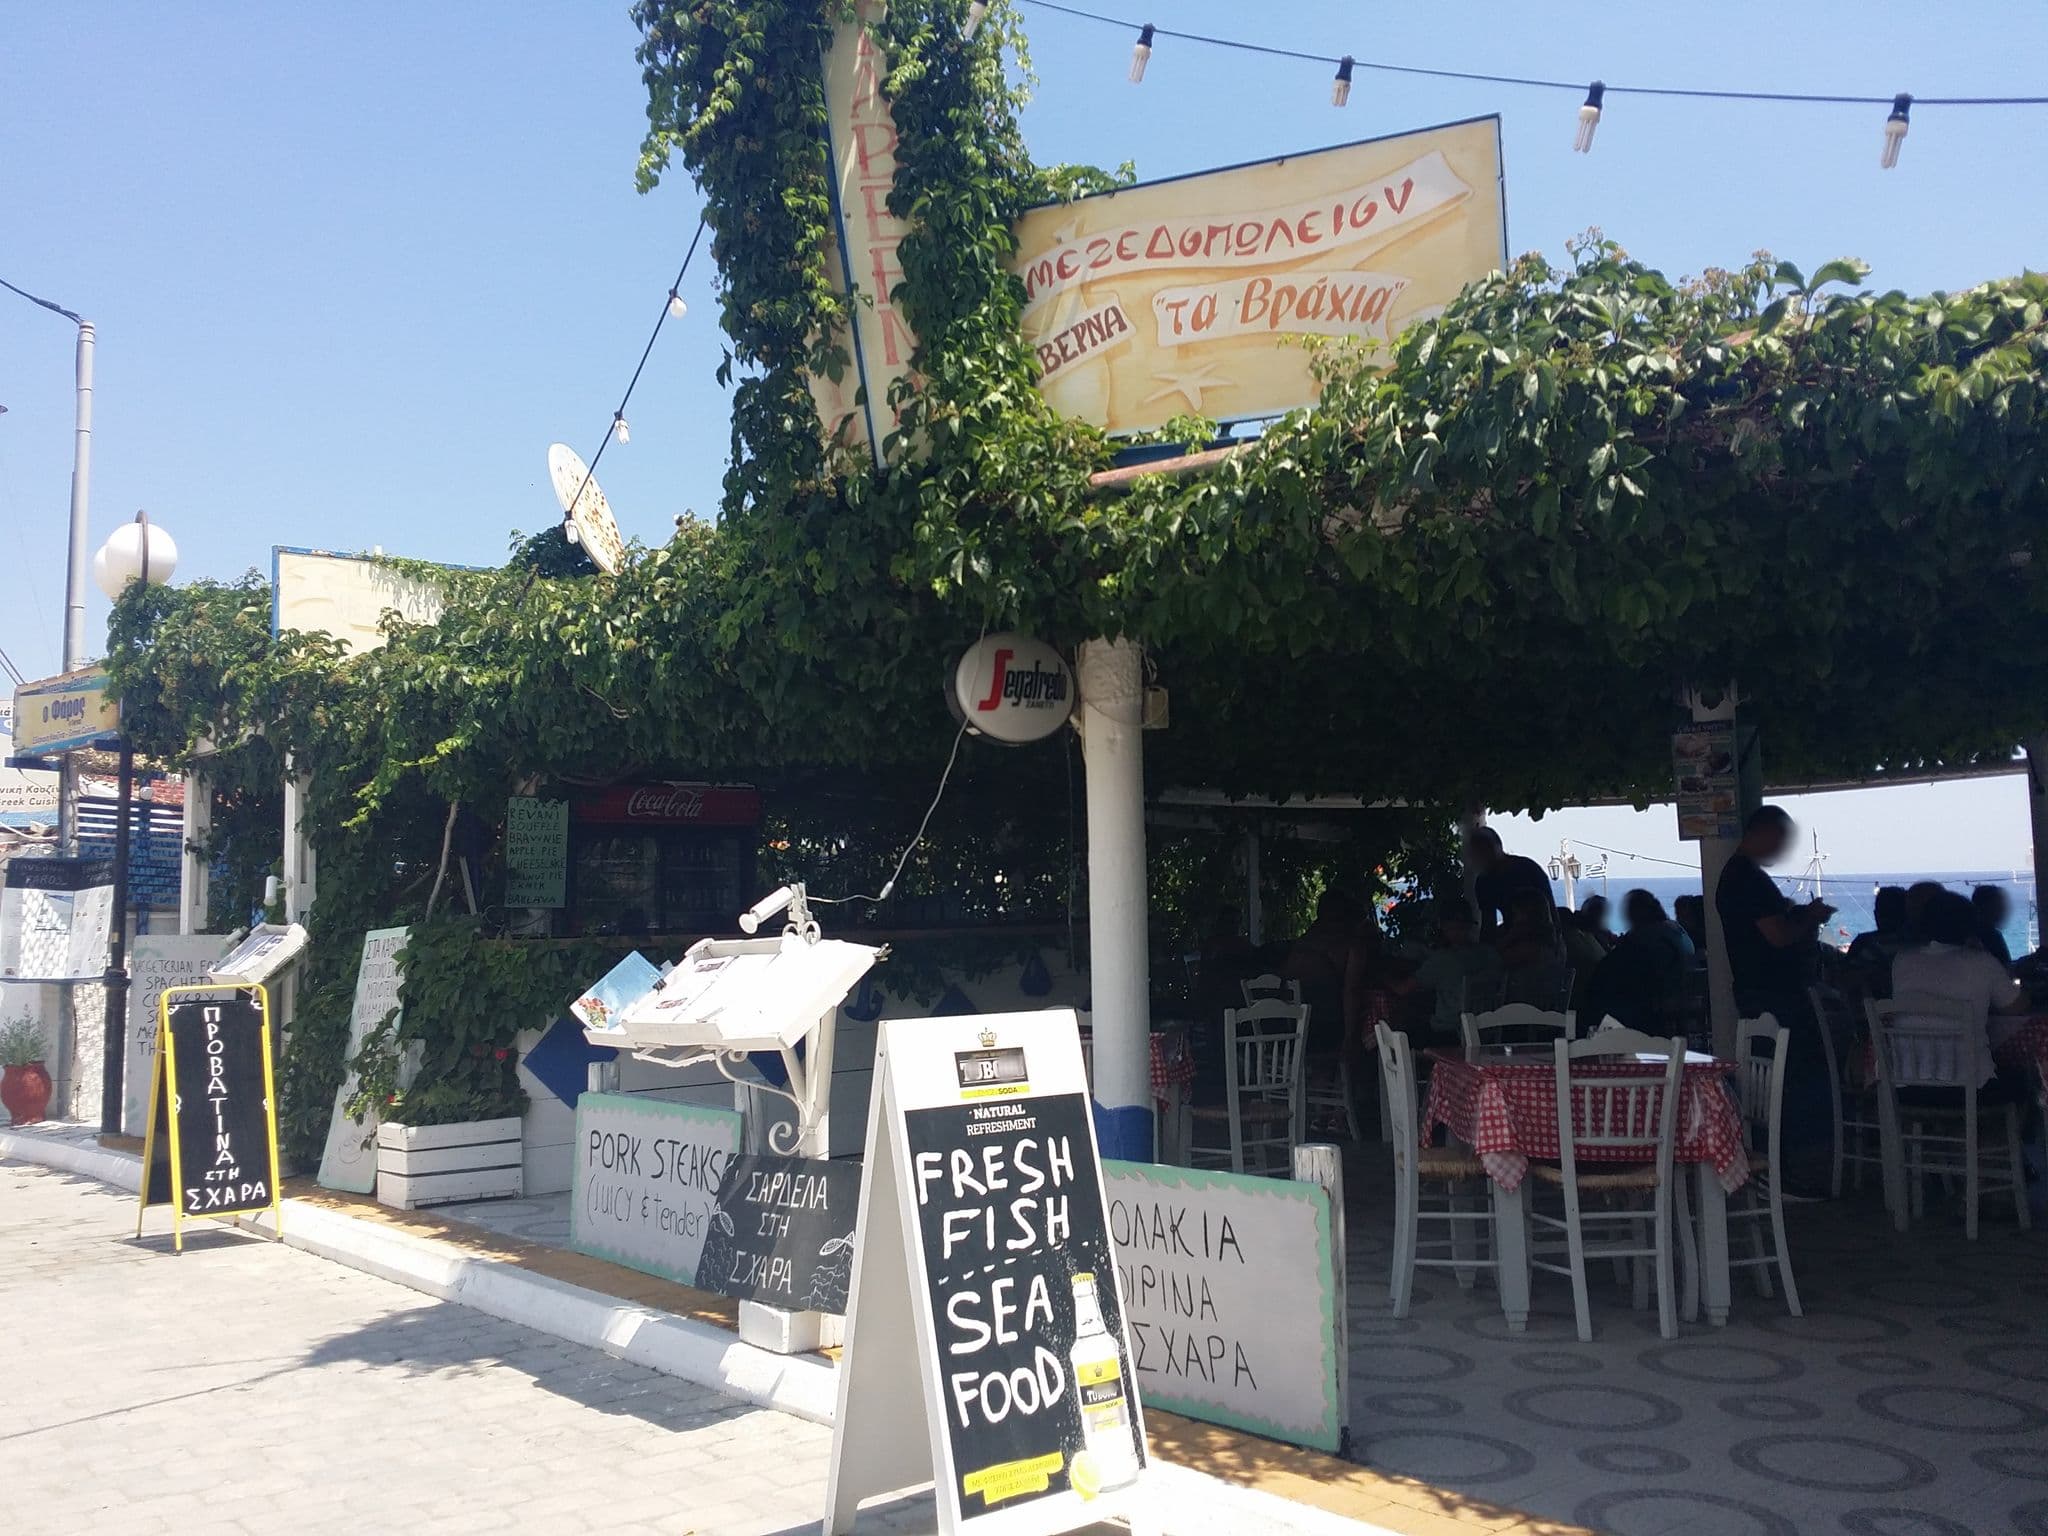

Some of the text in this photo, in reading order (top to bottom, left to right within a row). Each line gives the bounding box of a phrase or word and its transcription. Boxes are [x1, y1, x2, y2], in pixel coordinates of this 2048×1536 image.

[1037, 304, 1128, 376] ΒΕΡΝΑ
[977, 648, 1068, 711] Segafredo
[0, 784, 61, 795] νική Κουζίν
[0, 797, 25, 806] reek
[627, 786, 705, 818] Coca-Cola
[510, 808, 560, 820] REVANI
[509, 833, 562, 845] BRAWNIE
[541, 846, 558, 856] PIE
[203, 1006, 235, 1166] ΠΡΟΒΑΤΙΝΑ
[998, 1087, 1018, 1095] SODA
[966, 1117, 1037, 1137] REFRESHMENT
[973, 1103, 1027, 1120] NATURAL
[589, 1129, 724, 1196] PORK STEAKS
[915, 1135, 1074, 1205] FRESH
[185, 1180, 267, 1210] ΣΧΑΡΑ
[745, 1170, 829, 1211] ΣΑΡΔΕΛΑ
[756, 1211, 792, 1239] ΣΤΗ
[943, 1194, 1071, 1259] FISH
[1110, 1199, 1245, 1265] ΟΛΑΚΙΑ
[728, 1250, 792, 1295] ΣΧΑΡΑ
[947, 1274, 1054, 1355] SEA
[1131, 1320, 1258, 1391] ΣΧΑΡΑ
[951, 1345, 1066, 1429] FOOD
